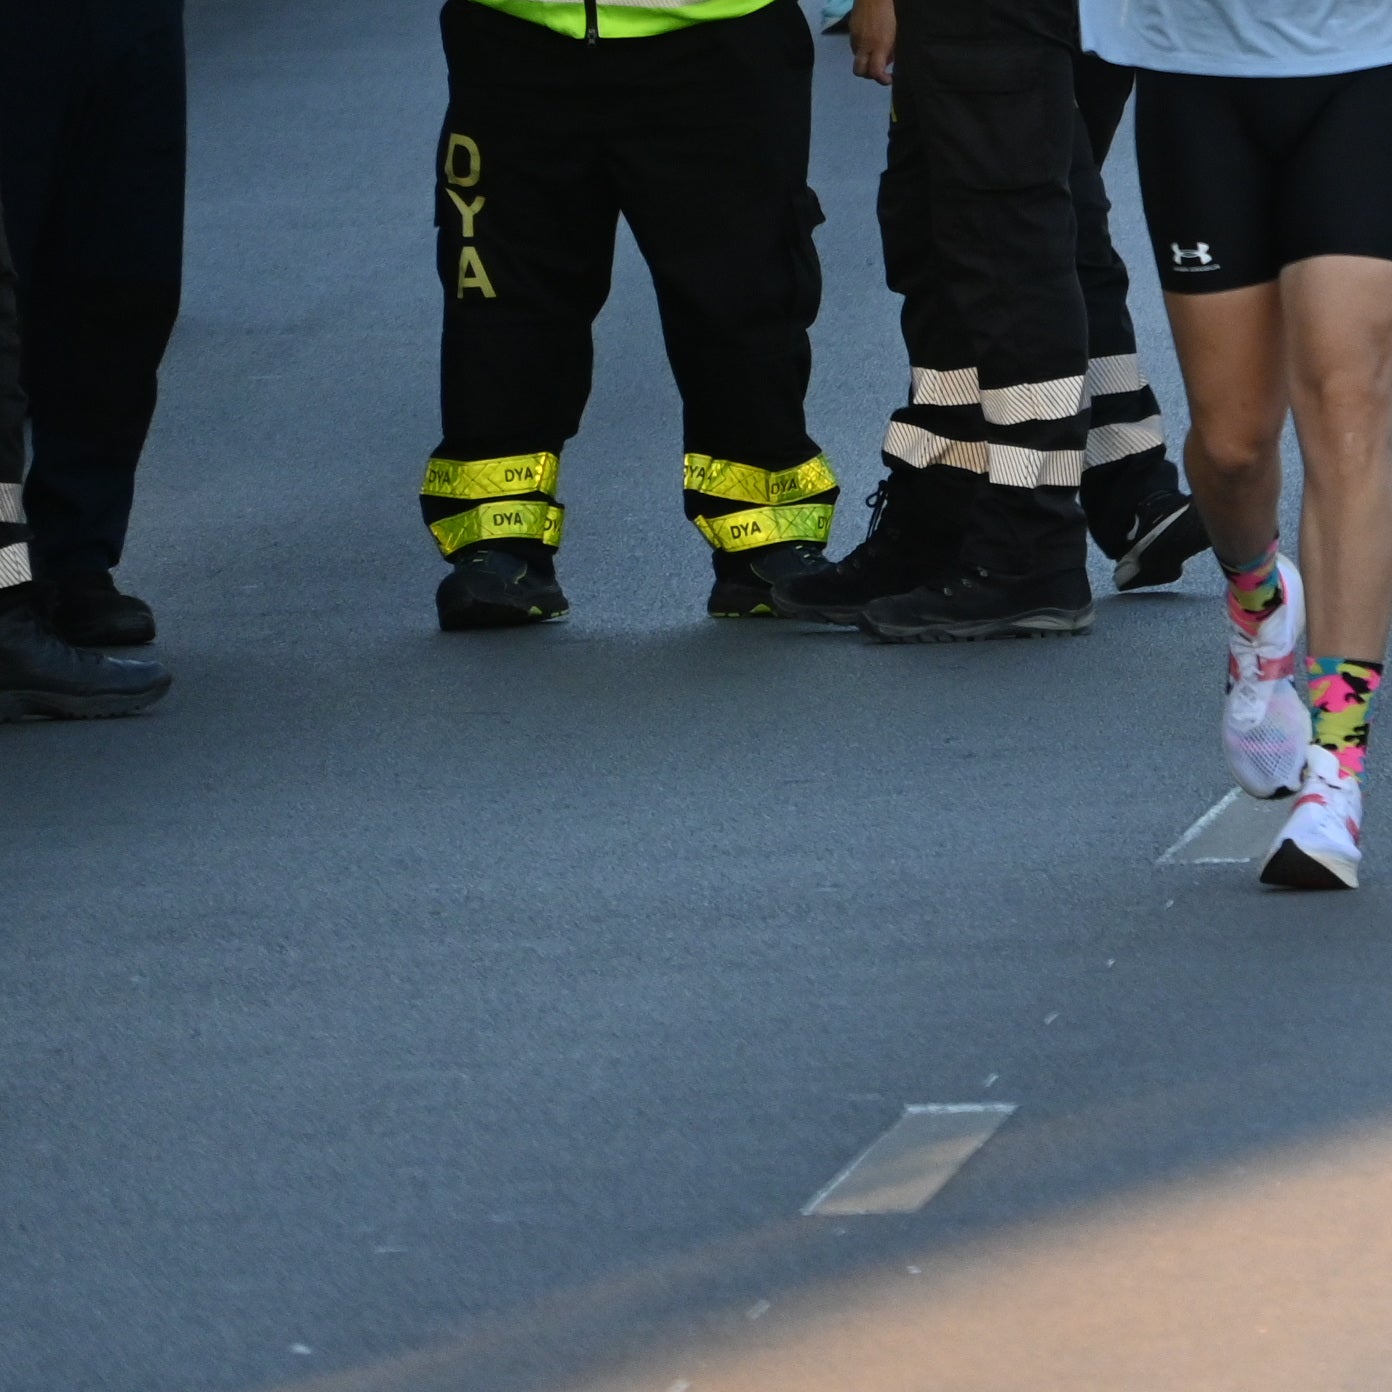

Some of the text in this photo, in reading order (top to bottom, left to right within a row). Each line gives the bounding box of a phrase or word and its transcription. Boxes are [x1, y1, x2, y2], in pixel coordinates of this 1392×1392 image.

[444, 132, 497, 300] DYA
[428, 467, 534, 485] DYA DYA
[771, 479, 797, 495] DYA
[493, 512, 523, 527] DYA
[730, 521, 762, 540] DYA
